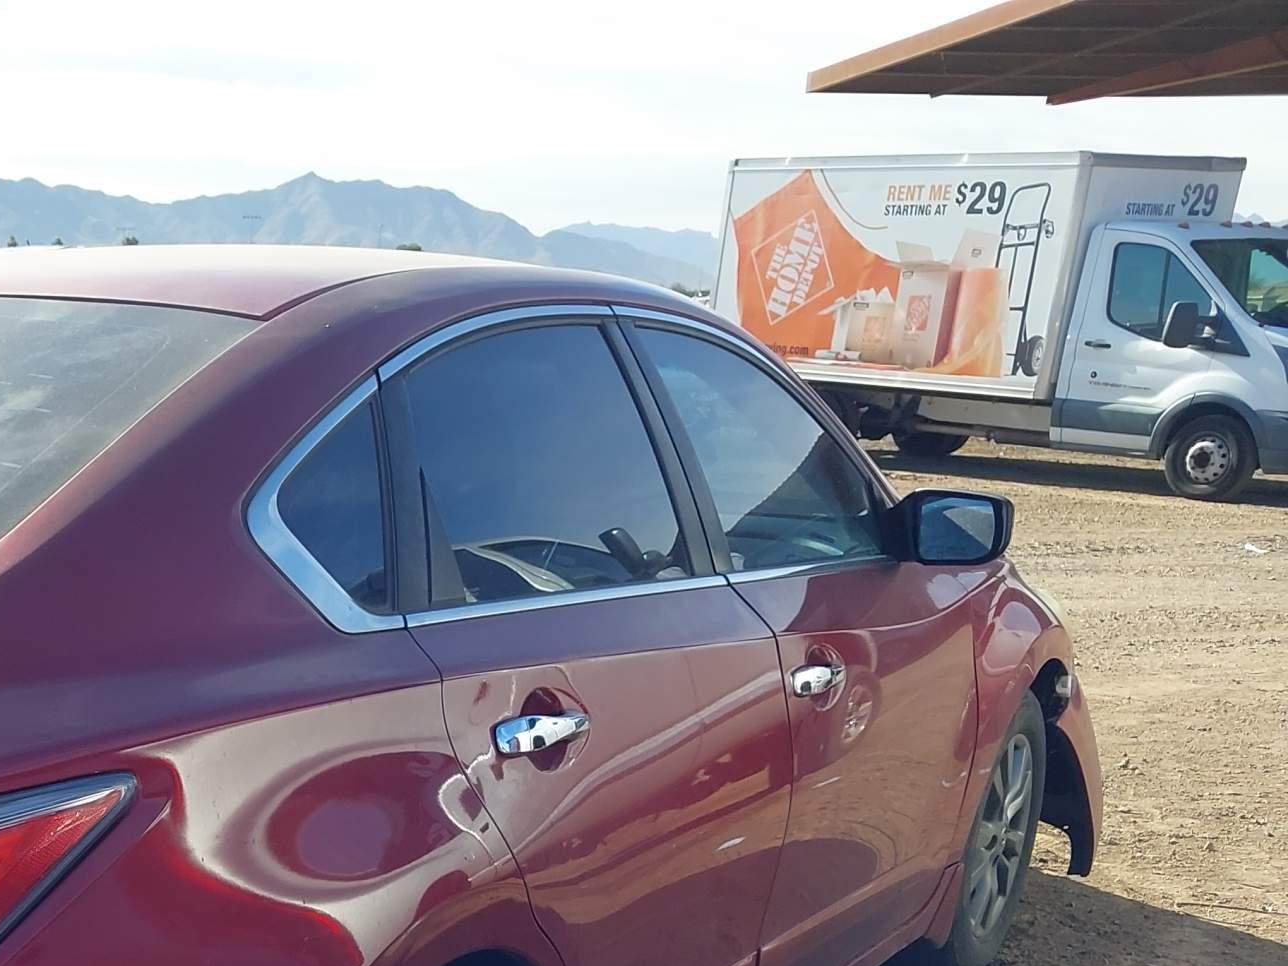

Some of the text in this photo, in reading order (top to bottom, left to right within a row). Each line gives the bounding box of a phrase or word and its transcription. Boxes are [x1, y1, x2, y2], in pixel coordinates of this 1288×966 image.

[884, 204, 948, 216] STARTING AT
[887, 181, 1007, 215] RENT ME $29
[1125, 203, 1176, 216] STARTING AT
[1181, 183, 1219, 216] $29
[765, 243, 788, 280] THE
[767, 217, 820, 317] HOME
[792, 241, 825, 306] DEPOT
